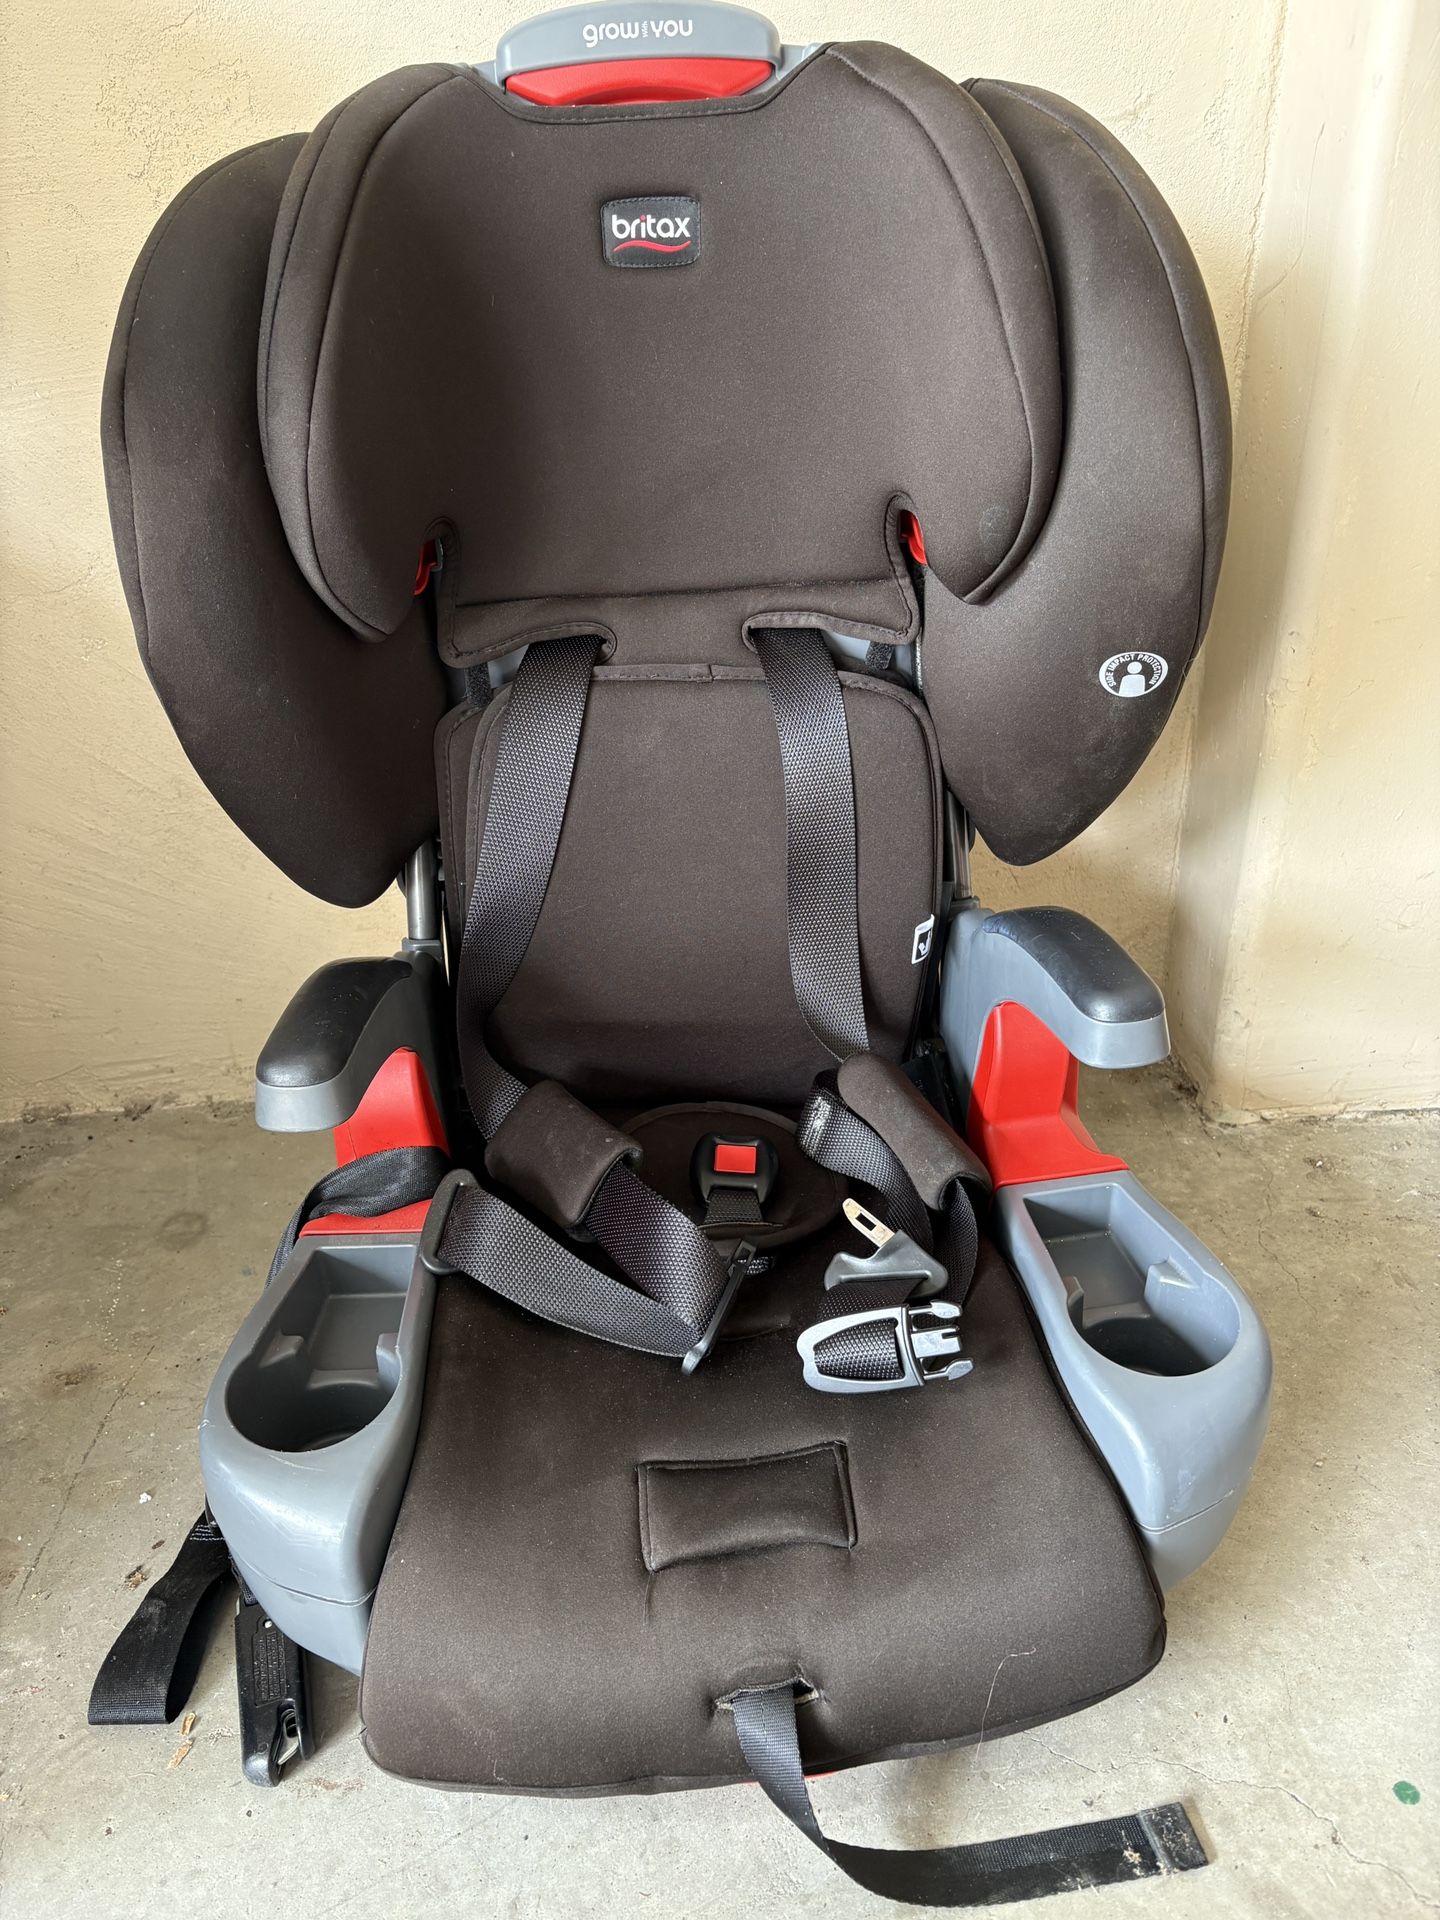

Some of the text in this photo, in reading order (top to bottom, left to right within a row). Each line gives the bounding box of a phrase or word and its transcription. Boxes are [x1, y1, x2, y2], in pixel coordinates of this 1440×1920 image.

[582, 21, 639, 48] grow
[611, 214, 691, 239] britax
[1105, 653, 1162, 687] SIDE IMPACT PROTECTION
